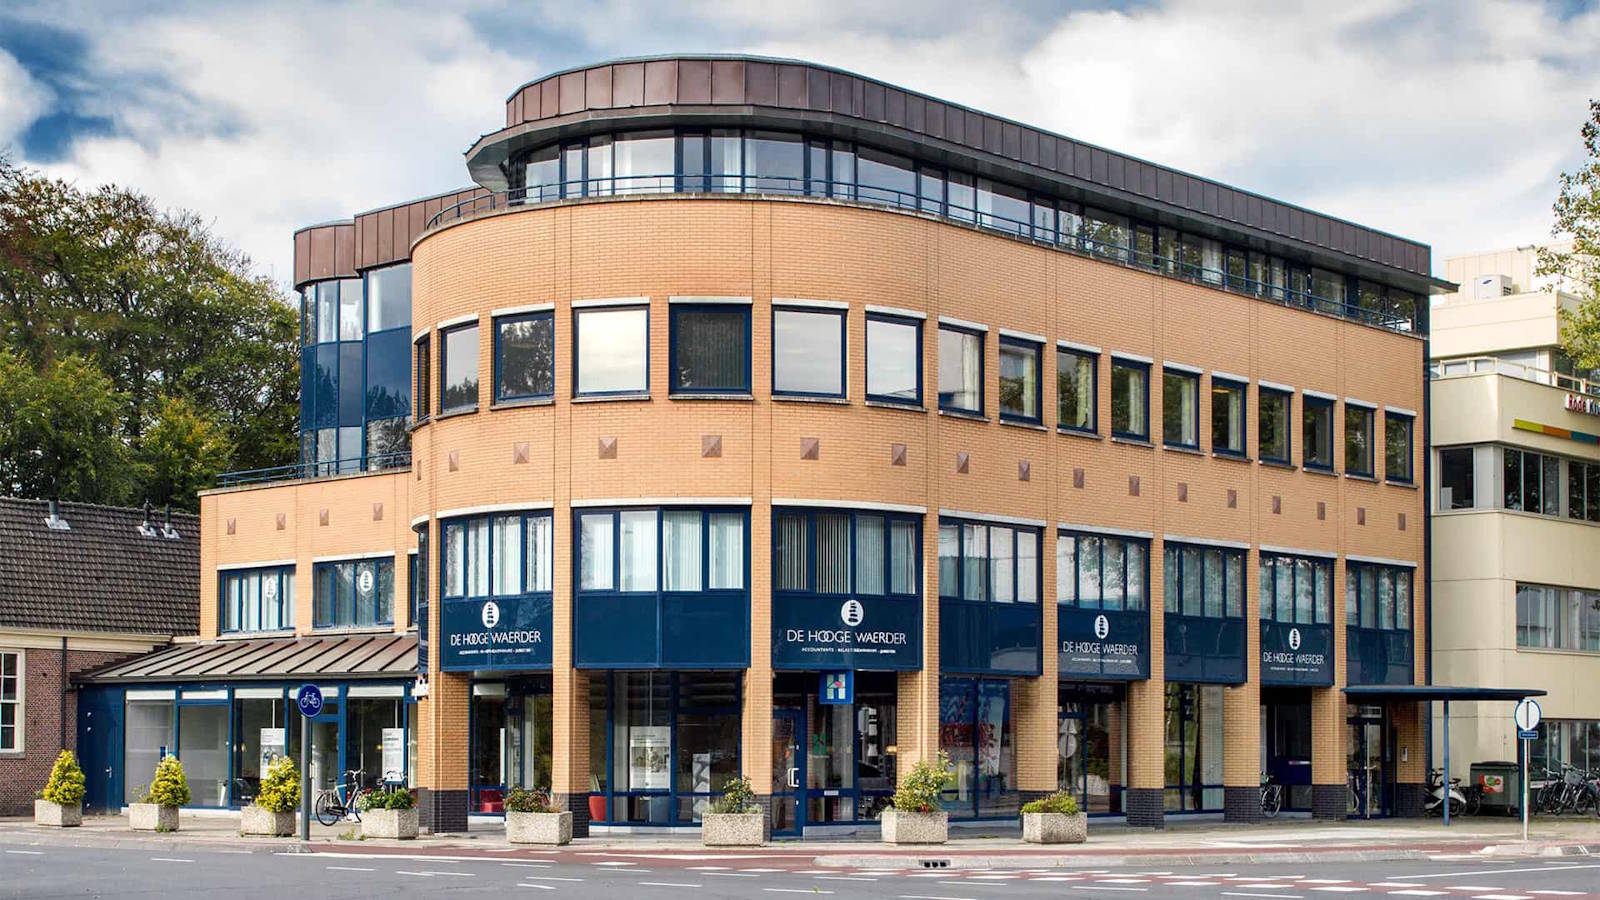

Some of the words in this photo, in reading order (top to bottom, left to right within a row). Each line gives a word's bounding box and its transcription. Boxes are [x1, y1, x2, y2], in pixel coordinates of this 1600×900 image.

[450, 634, 461, 646] DE
[462, 632, 488, 645] HOOGE
[491, 630, 541, 643] WAERDER
[786, 630, 804, 642] DE
[808, 631, 851, 643] HOOGE
[855, 632, 907, 645] WAERDER
[1063, 641, 1074, 652] DE
[1075, 642, 1100, 653] HOOGE
[1103, 643, 1137, 655] WAERDER
[1263, 652, 1272, 662] DE
[1273, 653, 1294, 664] HOOGE
[1296, 654, 1324, 665] WAERDER
